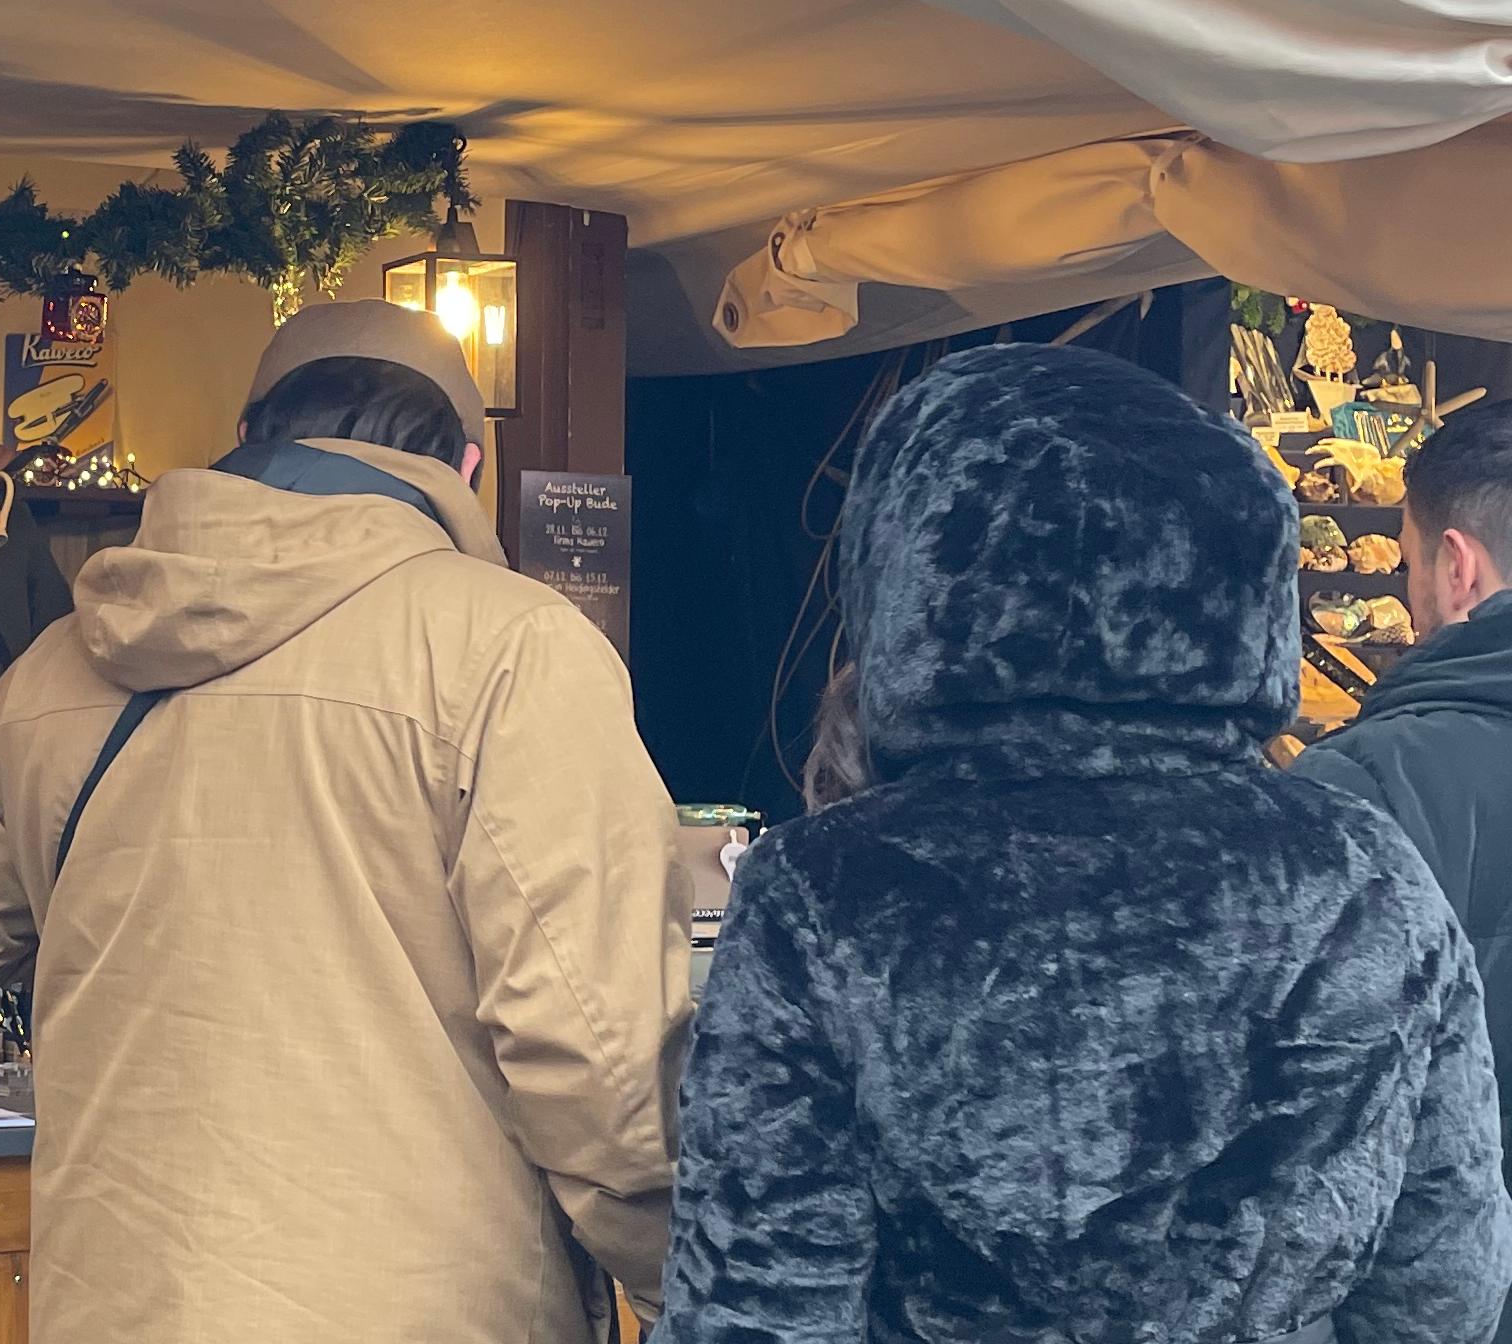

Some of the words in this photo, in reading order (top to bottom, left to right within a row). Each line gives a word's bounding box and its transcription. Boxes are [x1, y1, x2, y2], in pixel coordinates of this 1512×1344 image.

[21, 334, 102, 368] Kaweco
[544, 481, 606, 496] Aussteller
[538, 494, 582, 514] Pop-Up
[586, 497, 618, 511] Bude
